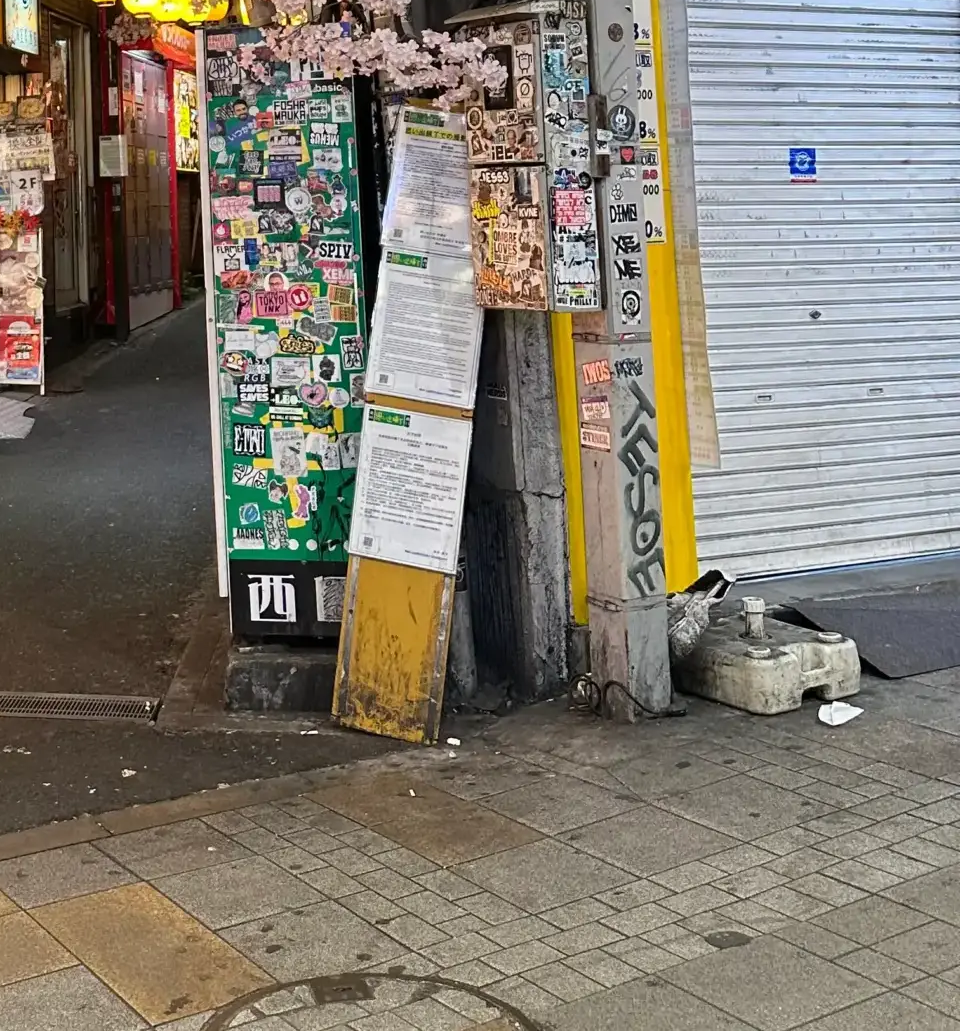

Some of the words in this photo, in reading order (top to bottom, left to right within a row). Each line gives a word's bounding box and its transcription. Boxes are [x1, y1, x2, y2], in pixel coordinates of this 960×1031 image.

[18, 177, 37, 190] 2F
[319, 242, 352, 259] SPIV
[258, 296, 285, 306] TOKYO
[264, 305, 281, 313] INK
